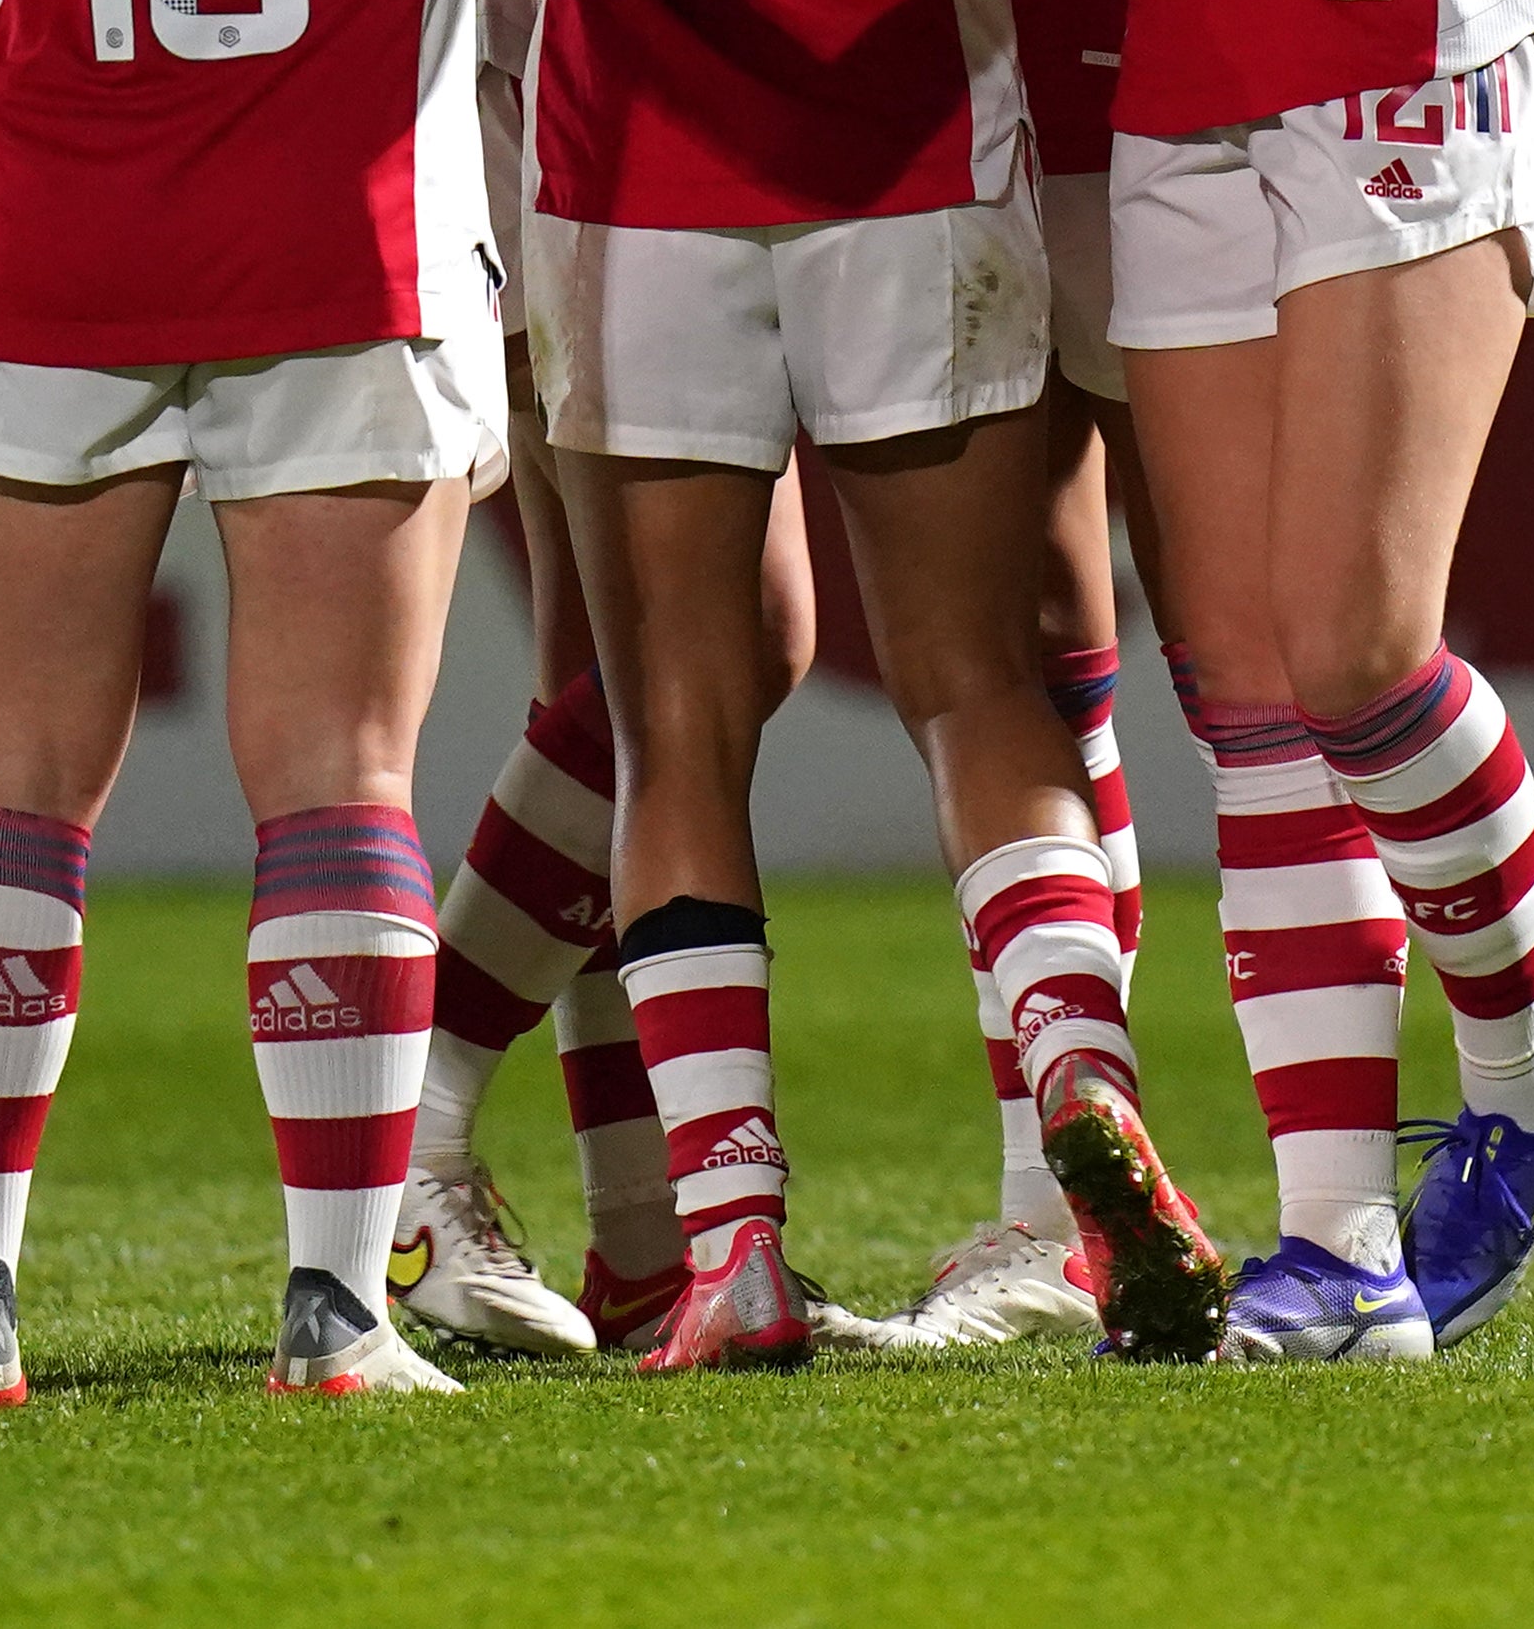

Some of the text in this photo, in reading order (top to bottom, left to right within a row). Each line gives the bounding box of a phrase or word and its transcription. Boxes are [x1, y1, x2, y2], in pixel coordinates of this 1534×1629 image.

[1364, 182, 1424, 201] adidas
[1404, 896, 1480, 920] FC
[251, 1004, 364, 1033] adidas
[702, 1144, 788, 1171] adida
